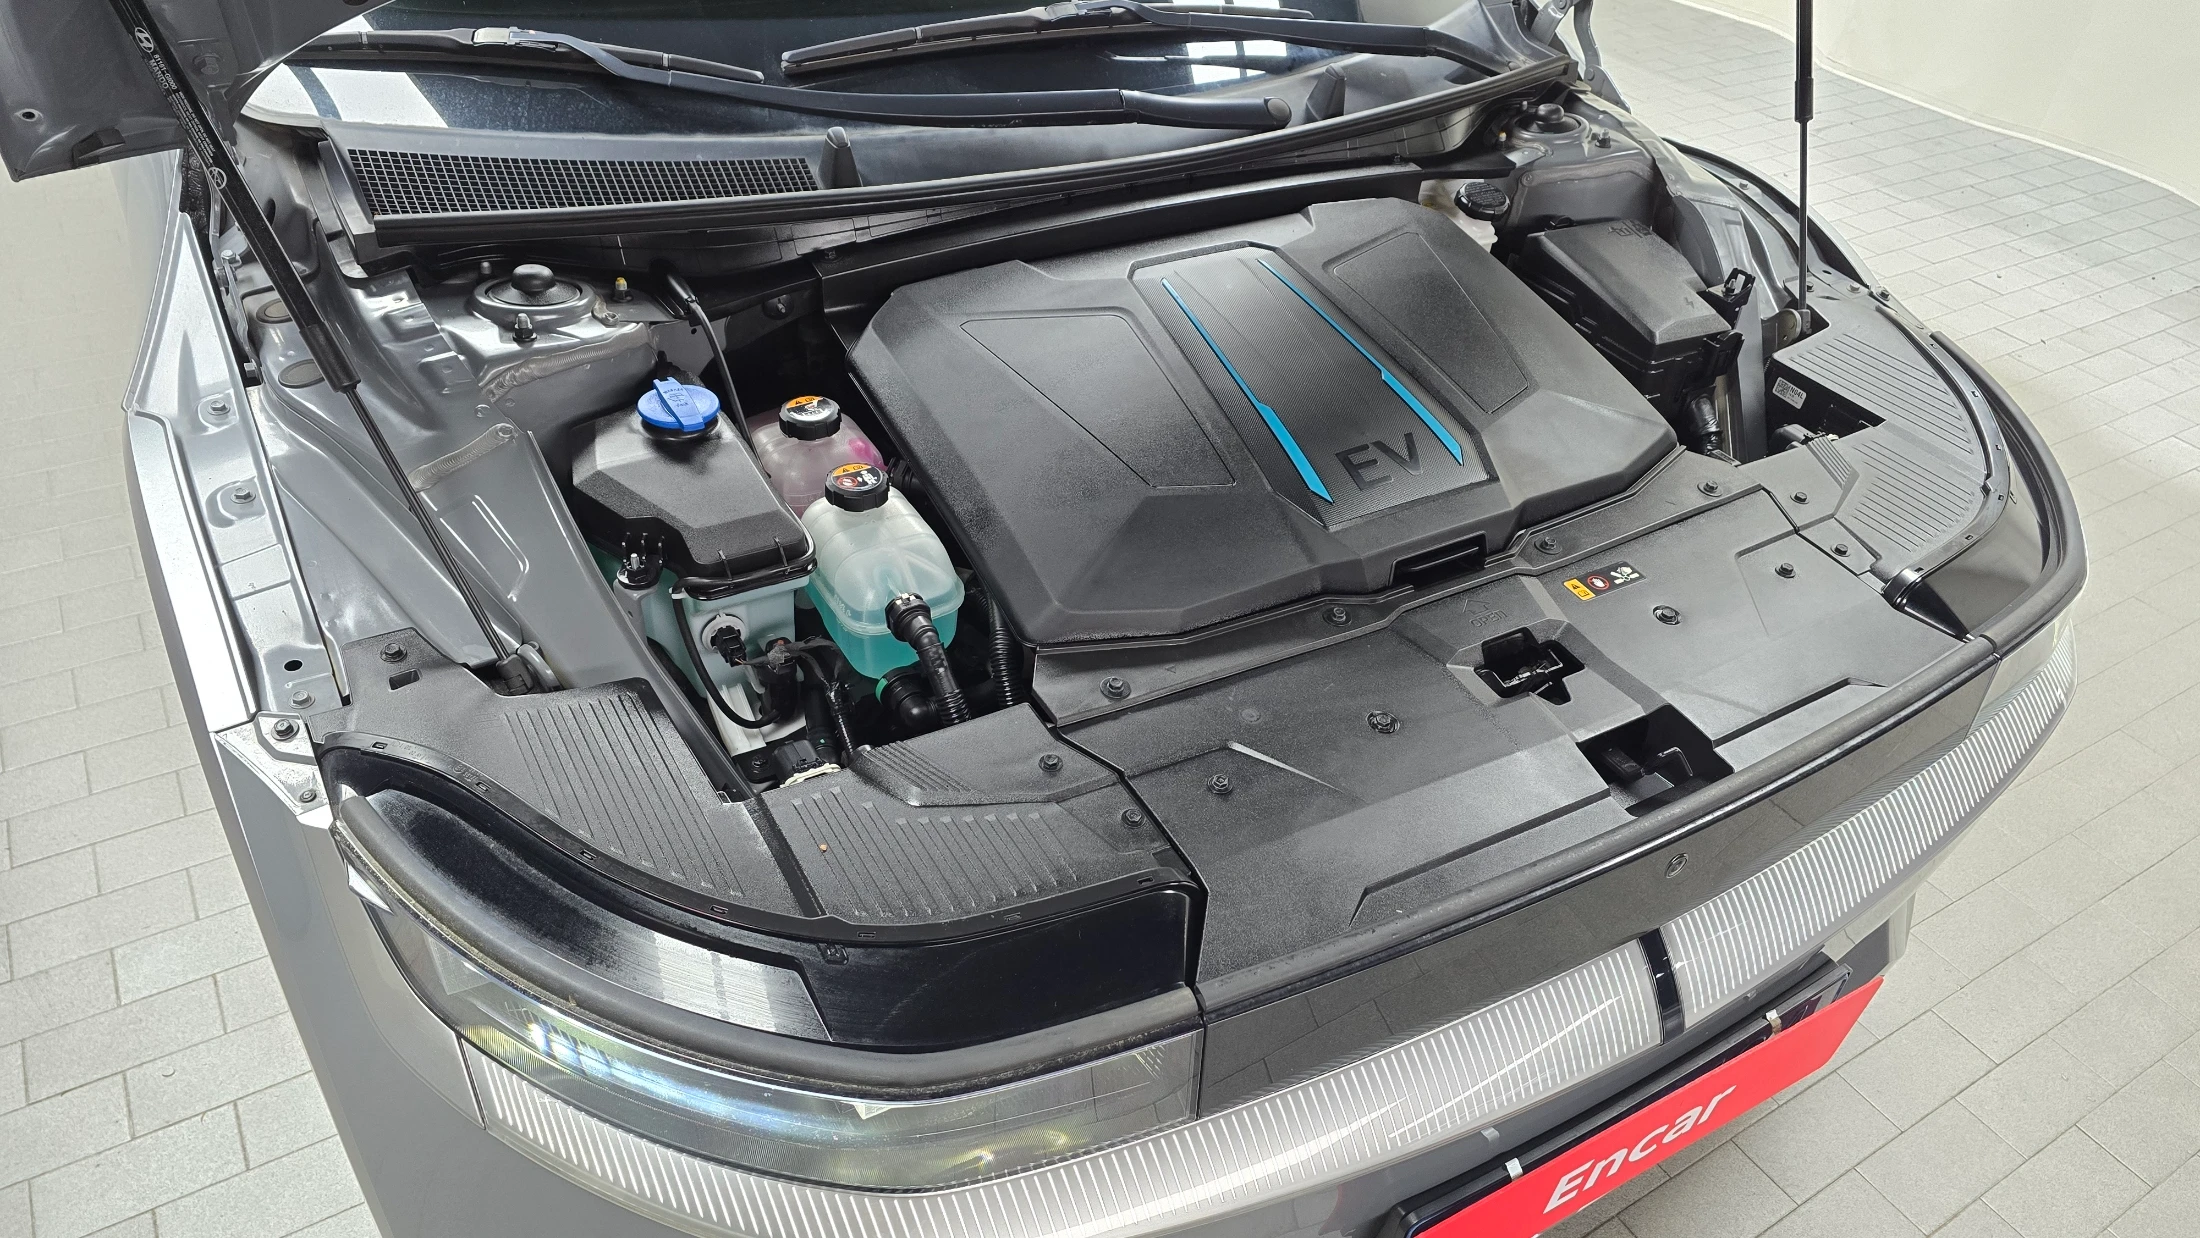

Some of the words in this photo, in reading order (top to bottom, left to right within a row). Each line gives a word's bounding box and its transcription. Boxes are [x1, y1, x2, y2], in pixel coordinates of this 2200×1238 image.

[148, 59, 170, 90] MANDO
[1335, 432, 1423, 491] EV
[1469, 609, 1508, 628] OPEN
[1543, 1085, 1736, 1214] Encar
